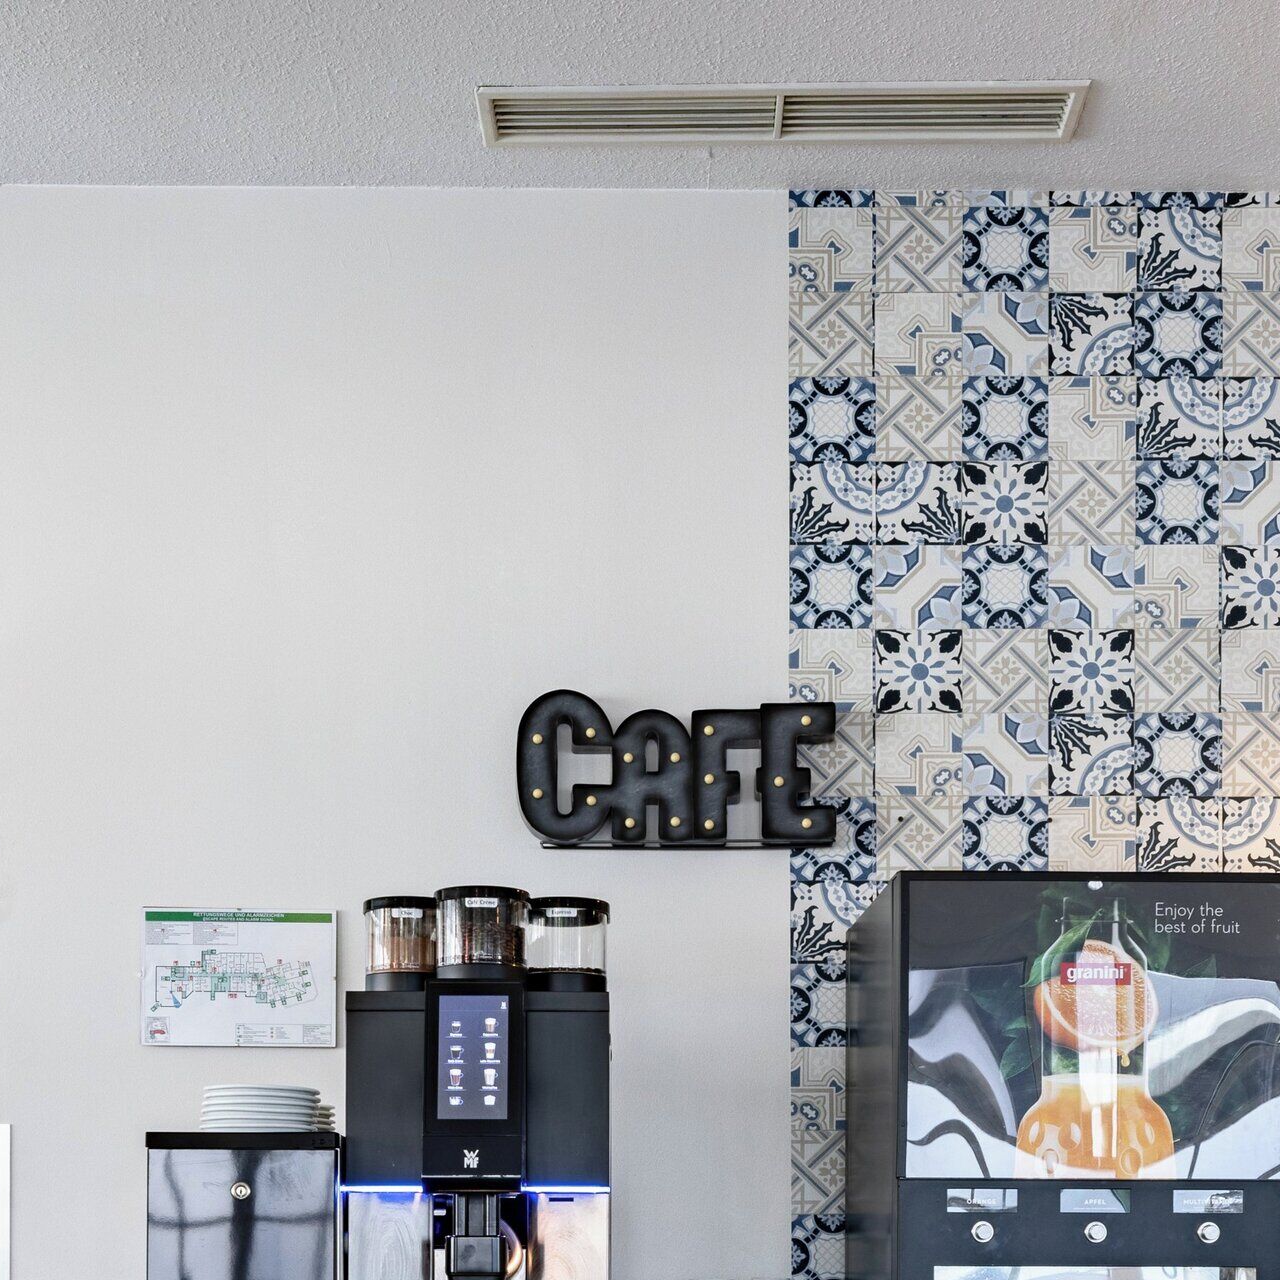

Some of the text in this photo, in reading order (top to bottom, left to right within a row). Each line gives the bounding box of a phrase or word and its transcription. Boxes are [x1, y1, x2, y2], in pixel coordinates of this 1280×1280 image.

[517, 689, 836, 842] CAFE
[1154, 902, 1224, 918] Enjoy the
[1154, 920, 1241, 935] best of fruit
[1066, 964, 1125, 983] granini
